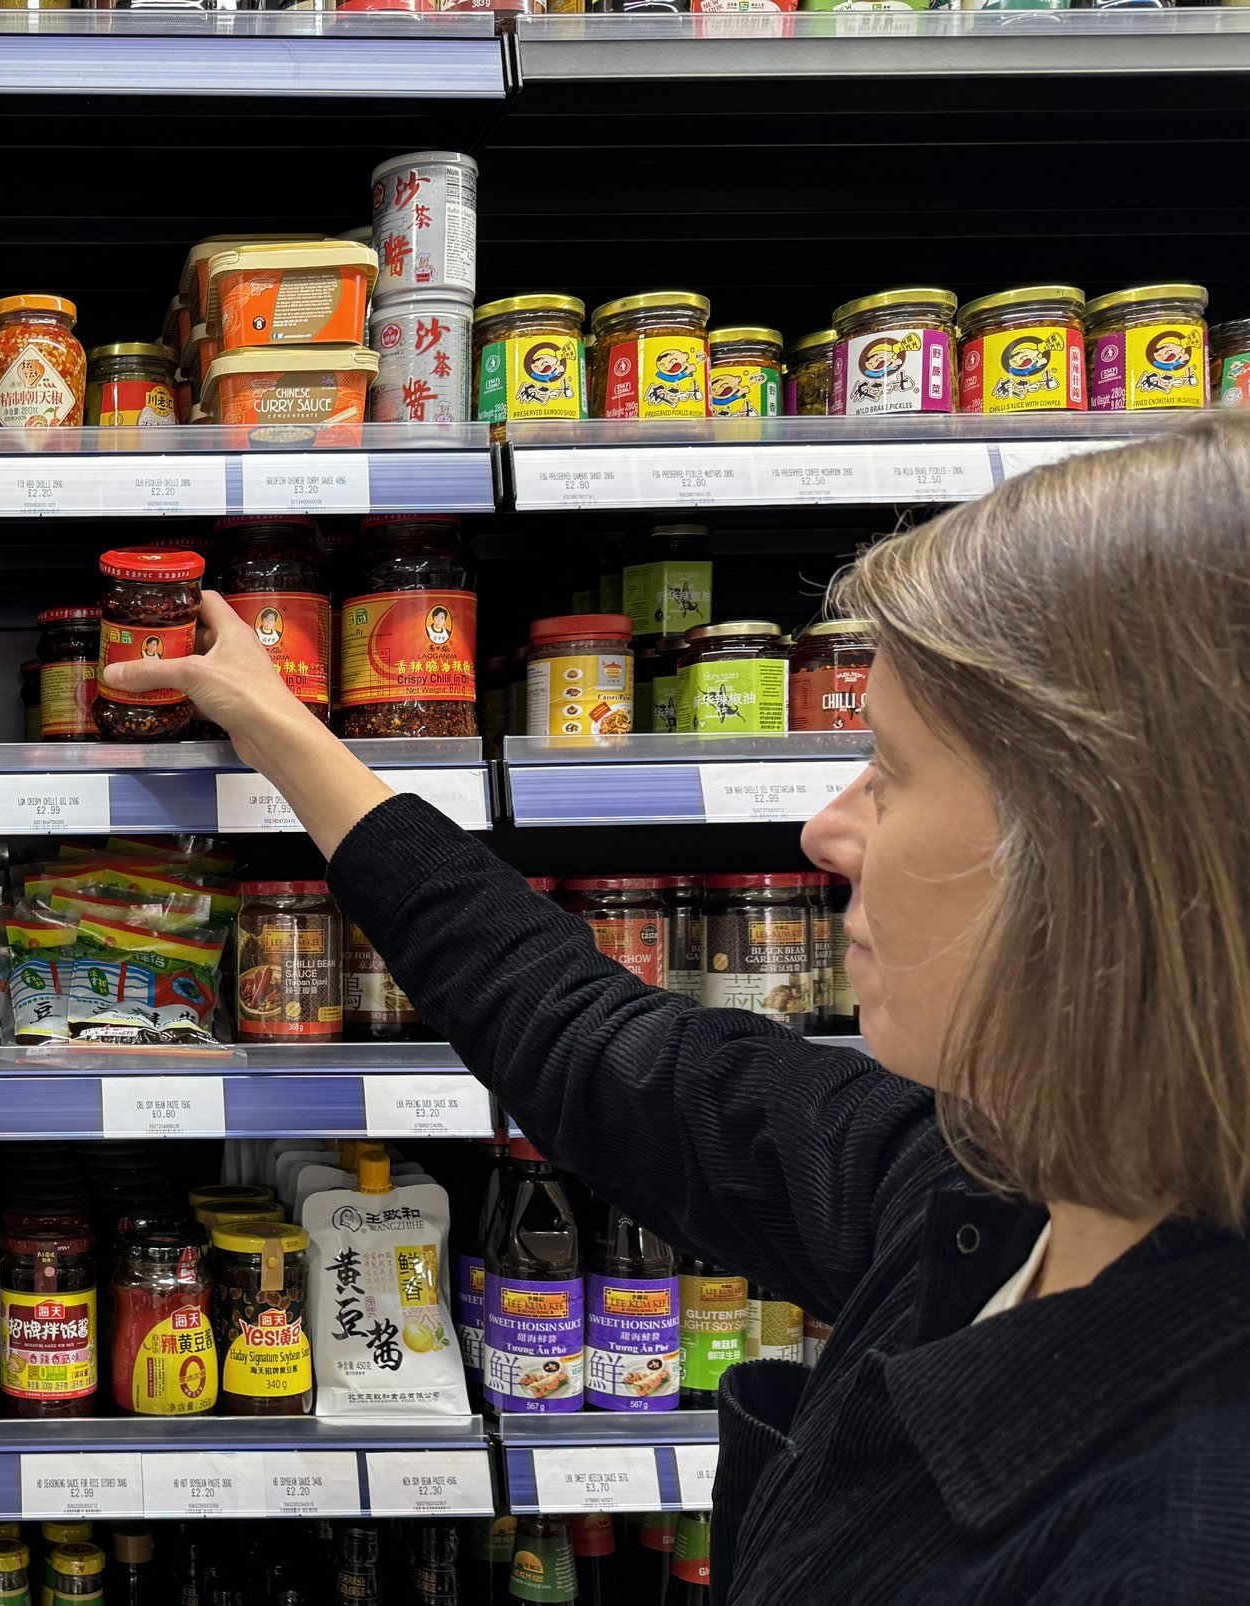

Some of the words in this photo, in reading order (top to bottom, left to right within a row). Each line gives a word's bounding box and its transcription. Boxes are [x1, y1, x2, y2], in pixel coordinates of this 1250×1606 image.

[276, 388, 310, 398] CHINESE
[254, 399, 292, 413] CURRY
[296, 398, 332, 412] SAUCE
[888, 402, 912, 411] PICKLES
[1024, 402, 1038, 410] WITH
[513, 410, 543, 418] PRESERVED
[544, 408, 563, 417] BAMBOO
[682, 479, 706, 487] £2.80
[801, 477, 825, 485] £2.50
[918, 475, 942, 484] £2.50
[294, 485, 318, 494] £3.20
[566, 481, 590, 489] £2.80
[28, 489, 52, 498] £2.20
[151, 488, 176, 496] £2.20
[397, 675, 427, 686] Crispy
[822, 693, 856, 709] CHILLI
[754, 794, 779, 803] £2.99
[36, 806, 60, 815] £2.99
[268, 804, 292, 813] £7.99
[752, 947, 782, 955] BLACK
[285, 960, 315, 968] CHILLI
[618, 954, 651, 964] CHOW
[746, 955, 782, 964] GARLIC
[285, 970, 317, 978] SAUCE
[152, 1110, 176, 1118] £0.80
[416, 1109, 439, 1118] £3.20
[366, 1206, 420, 1224] 王致和
[368, 1220, 424, 1232] WANGZHIHE
[507, 1298, 524, 1310] LEE
[526, 1298, 546, 1310] KUM
[548, 1298, 565, 1311] KEE
[609, 1298, 626, 1310] LEE
[628, 1298, 648, 1310] KUM
[650, 1298, 667, 1310] KEE
[686, 1308, 730, 1320] GLUTEN
[175, 1314, 200, 1327] 海天
[261, 1315, 285, 1327] 海天
[488, 1314, 516, 1329] SWEET
[517, 1318, 556, 1332] HOISIN
[557, 1317, 581, 1331] SAUCE
[589, 1314, 614, 1328] SWEET
[615, 1318, 657, 1331] HOISIN
[658, 1316, 680, 1330] SAUCE
[712, 1320, 735, 1332] SOY
[230, 1348, 248, 1363] Haday
[249, 1350, 278, 1365] Signature
[279, 1348, 301, 1364] Soybean
[298, 1477, 310, 1486] SAUCE
[286, 1486, 310, 1496] £2.20
[419, 1486, 442, 1496] £2.30
[586, 1483, 610, 1492] £3.70
[70, 1488, 94, 1498] £2.99
[191, 1488, 214, 1498] £2.20
